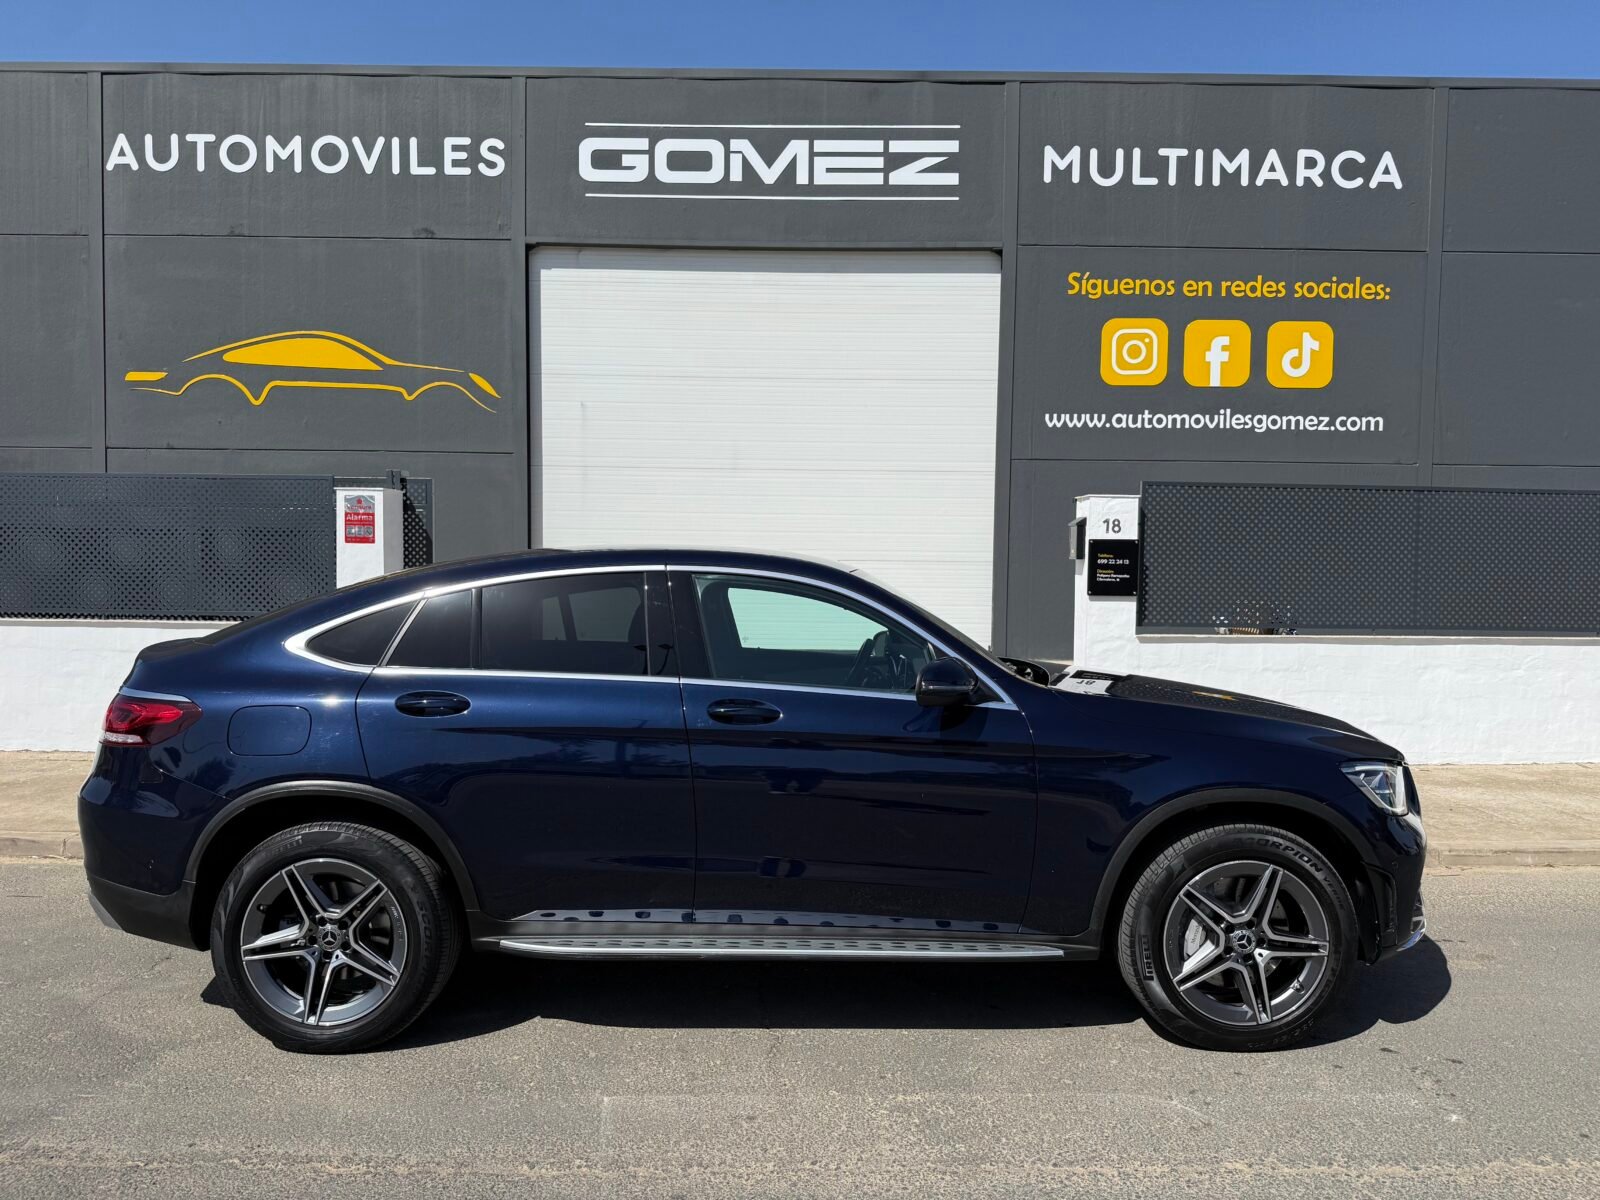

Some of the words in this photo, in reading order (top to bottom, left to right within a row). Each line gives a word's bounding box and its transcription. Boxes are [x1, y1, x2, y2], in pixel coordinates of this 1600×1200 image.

[106, 132, 506, 177] AUTOMOVILES
[578, 137, 960, 187] GOMEZ
[1043, 145, 1403, 190] MULTIMARCA
[1067, 271, 1176, 301] Síguenos
[1182, 279, 1213, 298] en
[1221, 275, 1287, 299] redes
[1294, 276, 1391, 301] sociales:
[1045, 408, 1384, 433] www.automovilesgomez.com
[346, 513, 373, 521] Alarma
[1103, 518, 1122, 534] 18
